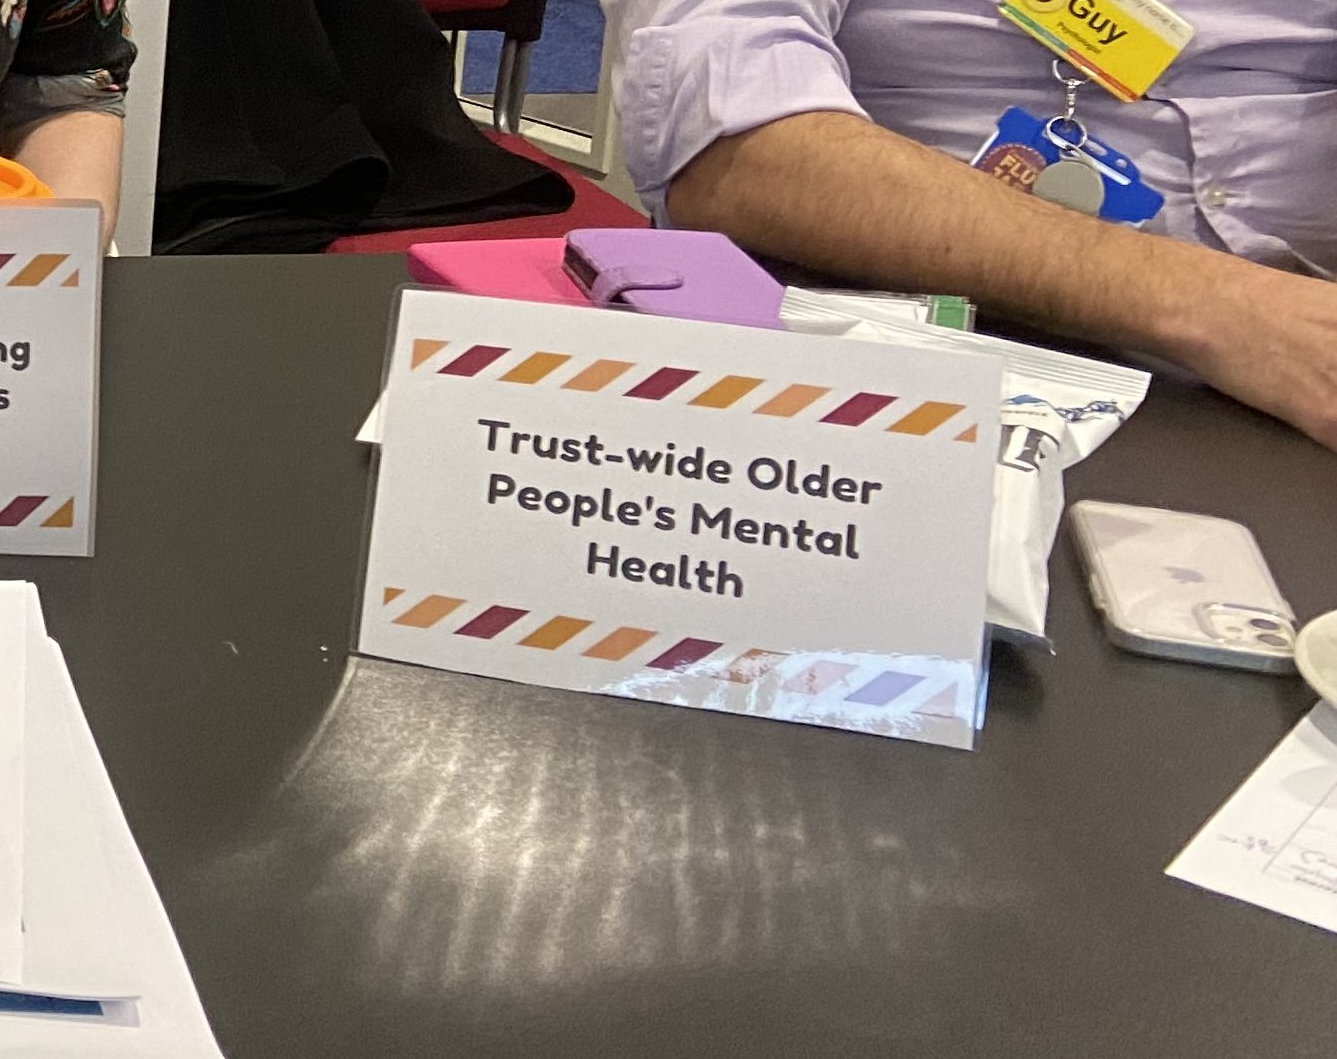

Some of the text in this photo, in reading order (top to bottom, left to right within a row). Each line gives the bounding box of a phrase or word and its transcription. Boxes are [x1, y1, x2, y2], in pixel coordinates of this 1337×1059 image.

[478, 418, 883, 505] Trust-wide Older
[487, 473, 860, 560] People's Mental
[587, 542, 745, 598] Health
